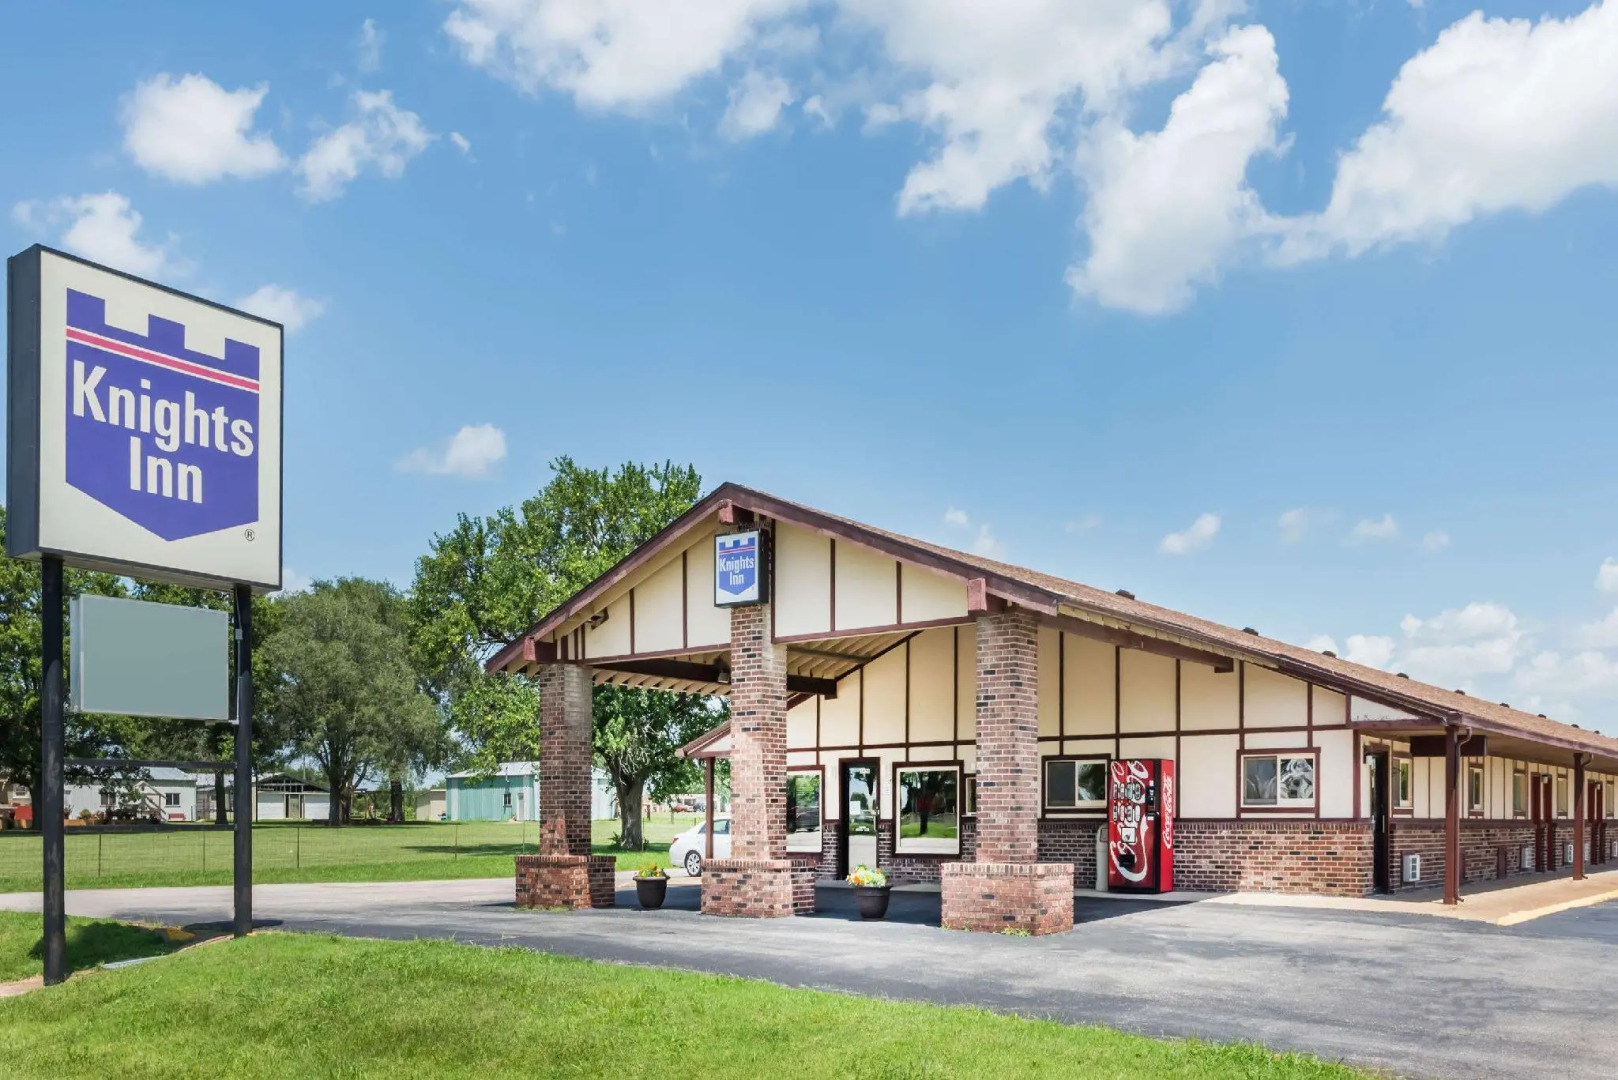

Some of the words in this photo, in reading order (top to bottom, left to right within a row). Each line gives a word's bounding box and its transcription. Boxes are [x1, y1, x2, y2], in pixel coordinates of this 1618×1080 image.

[73, 359, 254, 457] Knights
[129, 436, 203, 504] Inn
[720, 556, 754, 573] Knights
[730, 572, 744, 585] Inn
